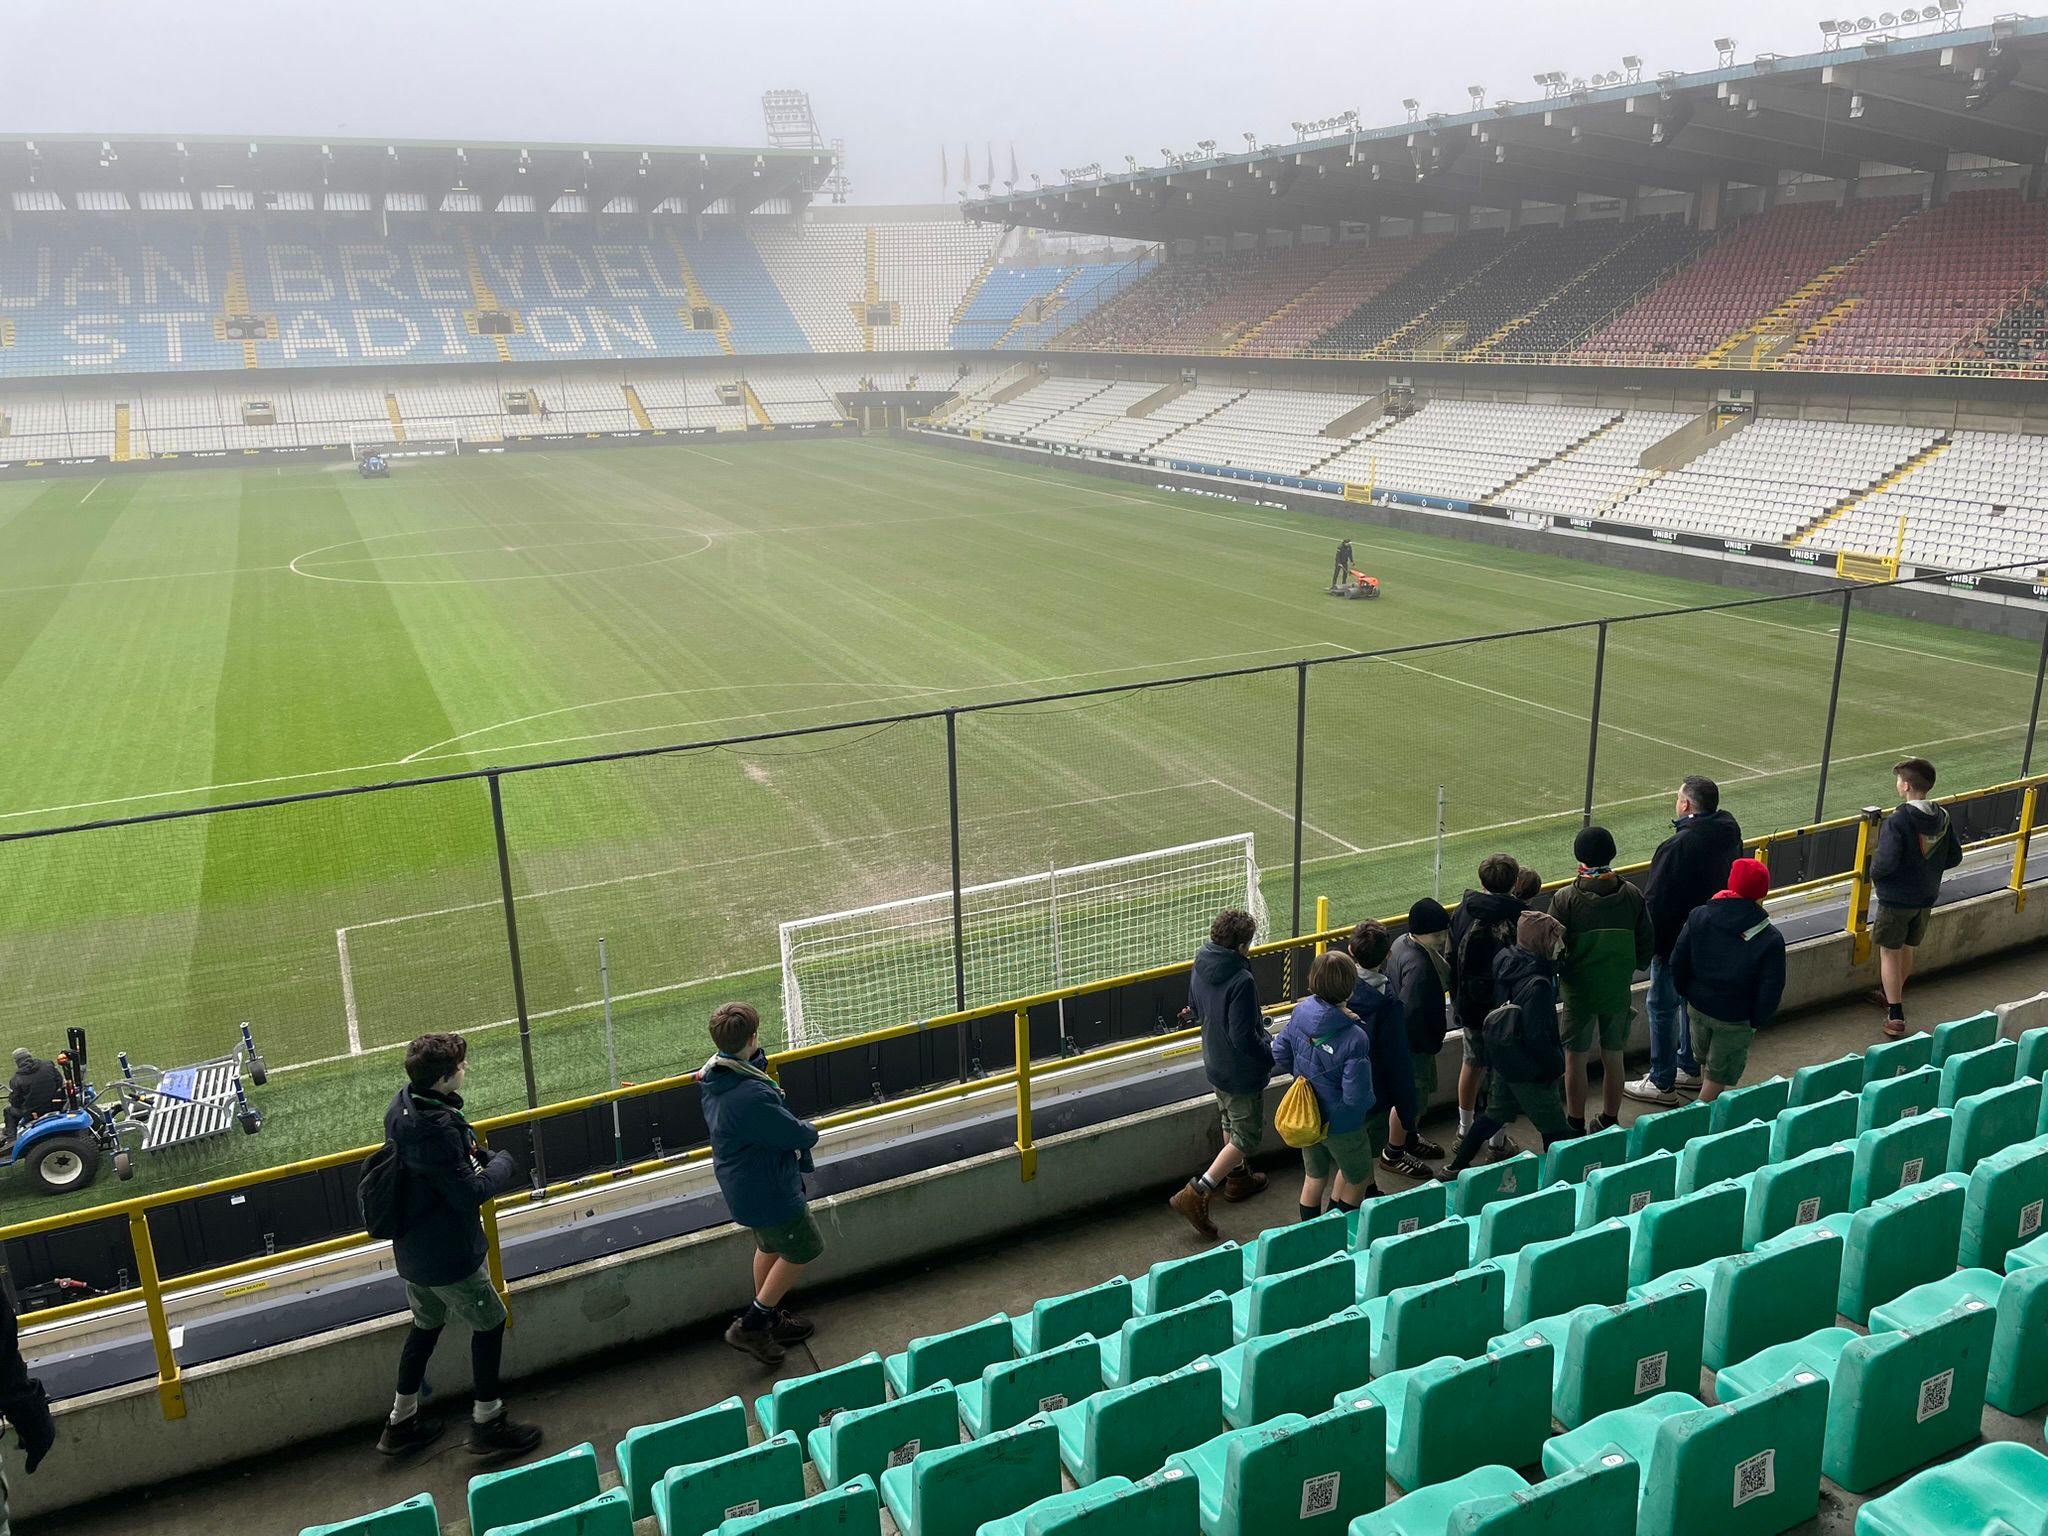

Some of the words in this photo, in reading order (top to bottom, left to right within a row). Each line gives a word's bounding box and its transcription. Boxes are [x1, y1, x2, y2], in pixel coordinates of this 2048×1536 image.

[0, 246, 210, 307] JAN
[267, 245, 689, 301] BREYDEL
[64, 305, 657, 366] STADION
[1570, 518, 1592, 528] UNIBET
[1652, 529, 1678, 541] UNIBET
[1724, 540, 1752, 551] UNIBET
[1789, 549, 1820, 561] UNIBET
[2032, 585, 2048, 596] UN
